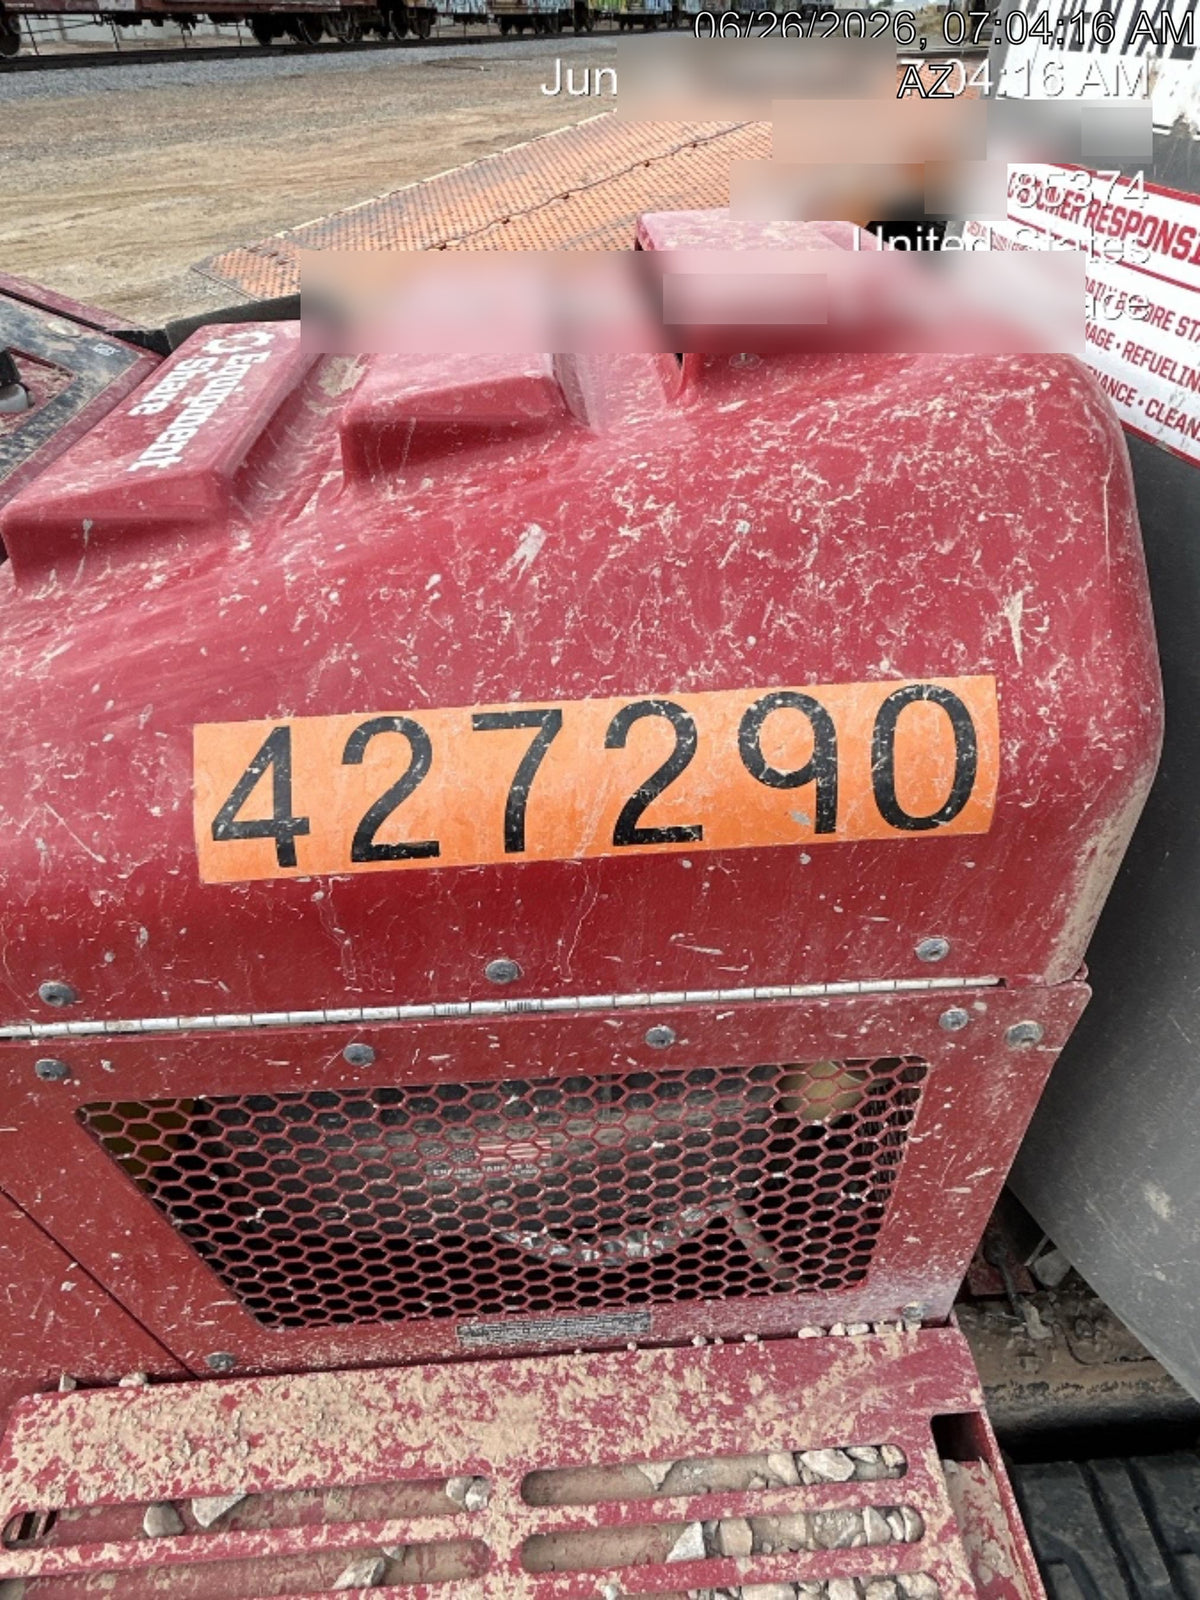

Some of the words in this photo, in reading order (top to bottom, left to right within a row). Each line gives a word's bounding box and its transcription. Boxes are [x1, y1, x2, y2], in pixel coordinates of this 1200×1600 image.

[1007, 172, 1085, 224] COMER
[126, 350, 273, 472] Equipment
[127, 356, 219, 417] Share
[210, 684, 980, 868] 427290
